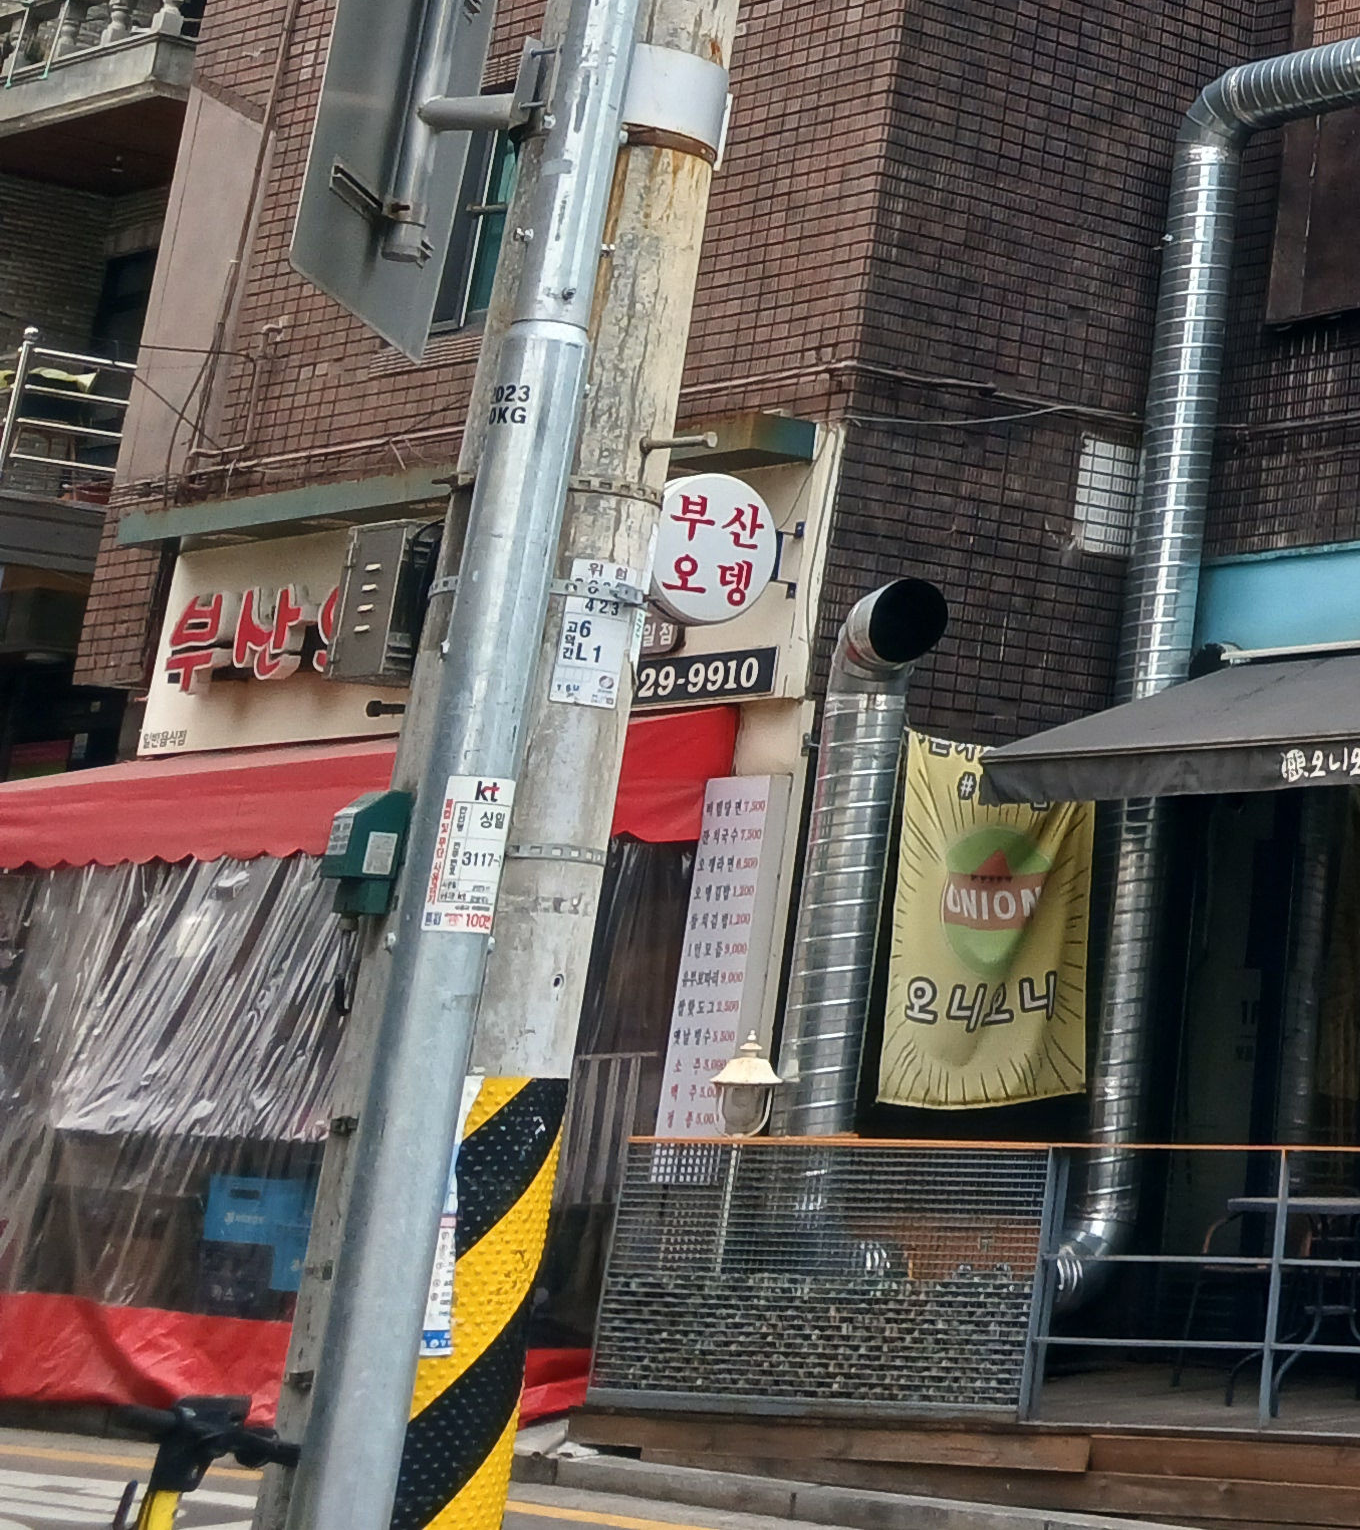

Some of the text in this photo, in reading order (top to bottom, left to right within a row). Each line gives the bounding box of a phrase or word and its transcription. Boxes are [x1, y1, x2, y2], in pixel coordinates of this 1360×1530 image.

[670, 494, 765, 552] 부산
[662, 555, 754, 608] 오뎅
[585, 599, 619, 616] 423
[579, 620, 592, 638] 6
[638, 657, 759, 697] 29-9910
[143, 730, 187, 749] 일반음식점
[475, 781, 500, 802] kt
[702, 827, 738, 845] 잔치국수
[905, 971, 1057, 1033] 오니오니
